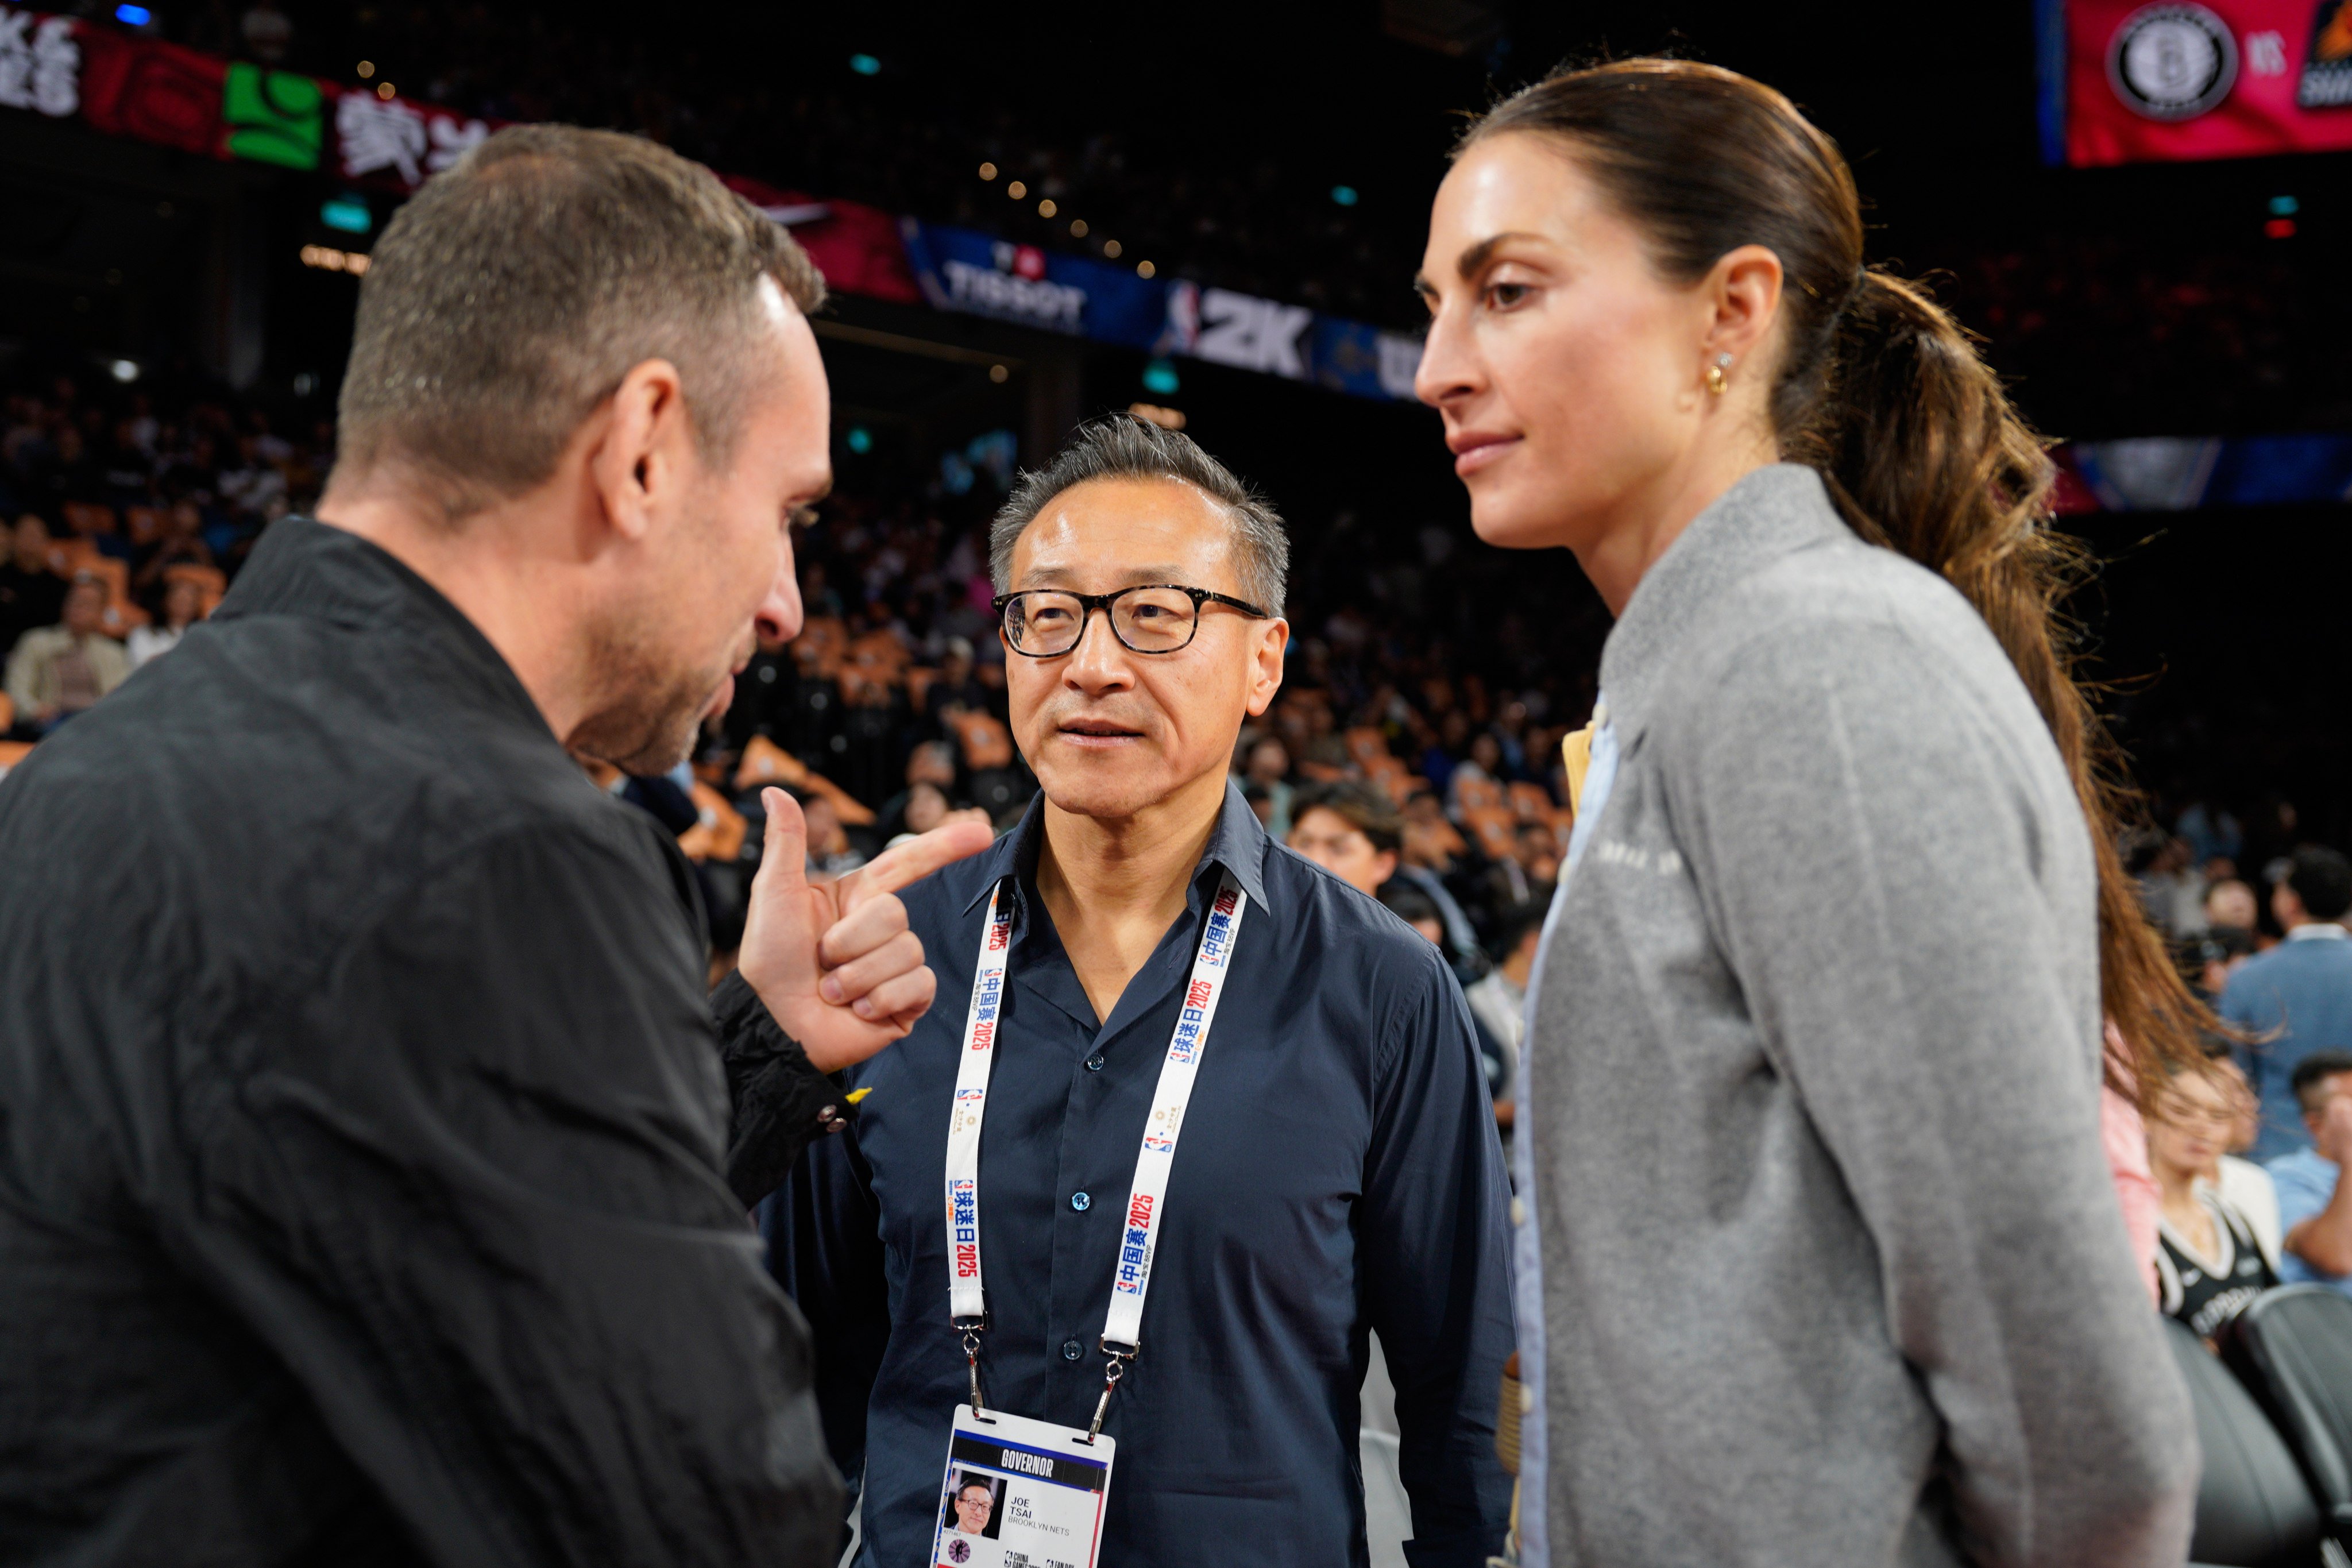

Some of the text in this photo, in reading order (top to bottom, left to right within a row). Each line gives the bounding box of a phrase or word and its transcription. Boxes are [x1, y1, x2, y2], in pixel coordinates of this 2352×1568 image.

[1196, 286, 1314, 379] 2K
[953, 1191, 978, 1277] 球迷日2025
[1119, 1193, 1154, 1281] 中国赛2025
[1001, 1449, 1054, 1478] GOVERNOR
[1010, 1506, 1032, 1519] TSAI
[1011, 1497, 1030, 1508] JOE
[1008, 1516, 1070, 1536] BROOKLYN NETS
[1013, 1552, 1029, 1563] CHINA
